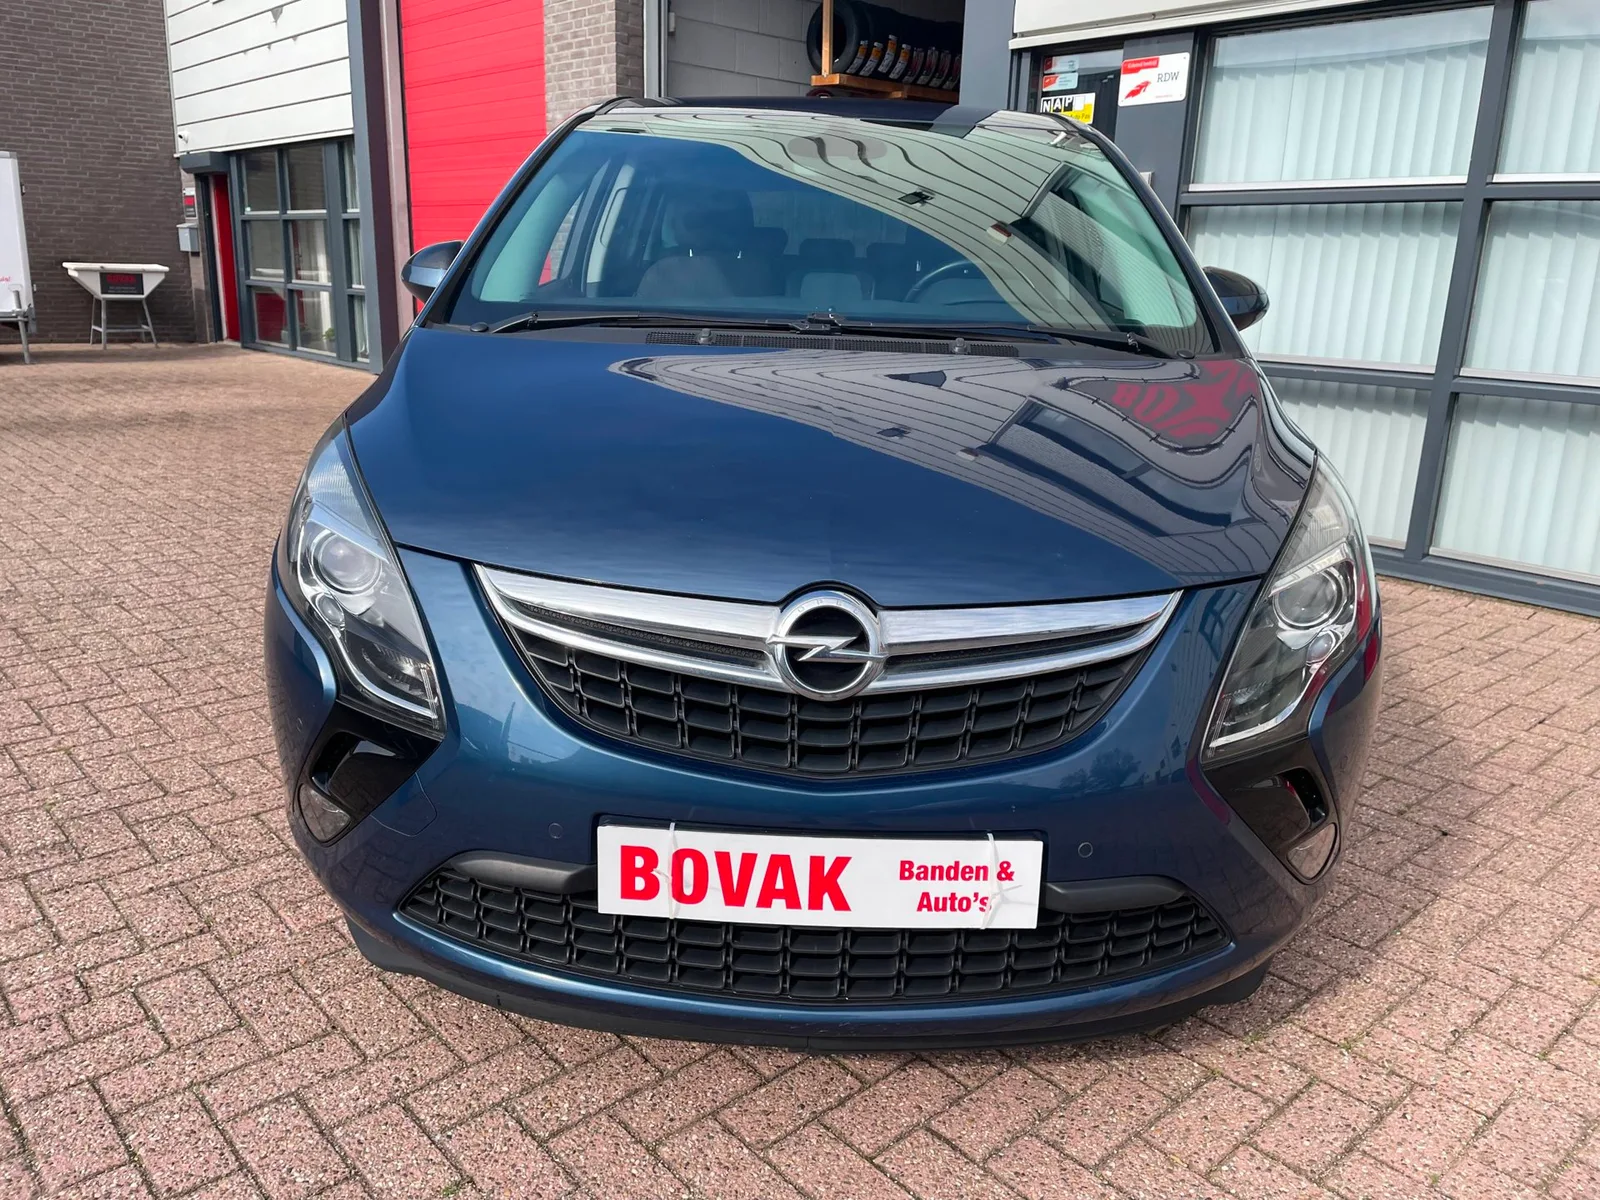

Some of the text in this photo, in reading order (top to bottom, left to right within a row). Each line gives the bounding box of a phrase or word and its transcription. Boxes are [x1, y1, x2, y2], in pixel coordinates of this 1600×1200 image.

[1157, 71, 1180, 83] RDW
[1043, 96, 1073, 113] NAP
[620, 845, 852, 912] BOVAK
[900, 860, 1015, 882] Banden &
[916, 891, 992, 912] Auto's
